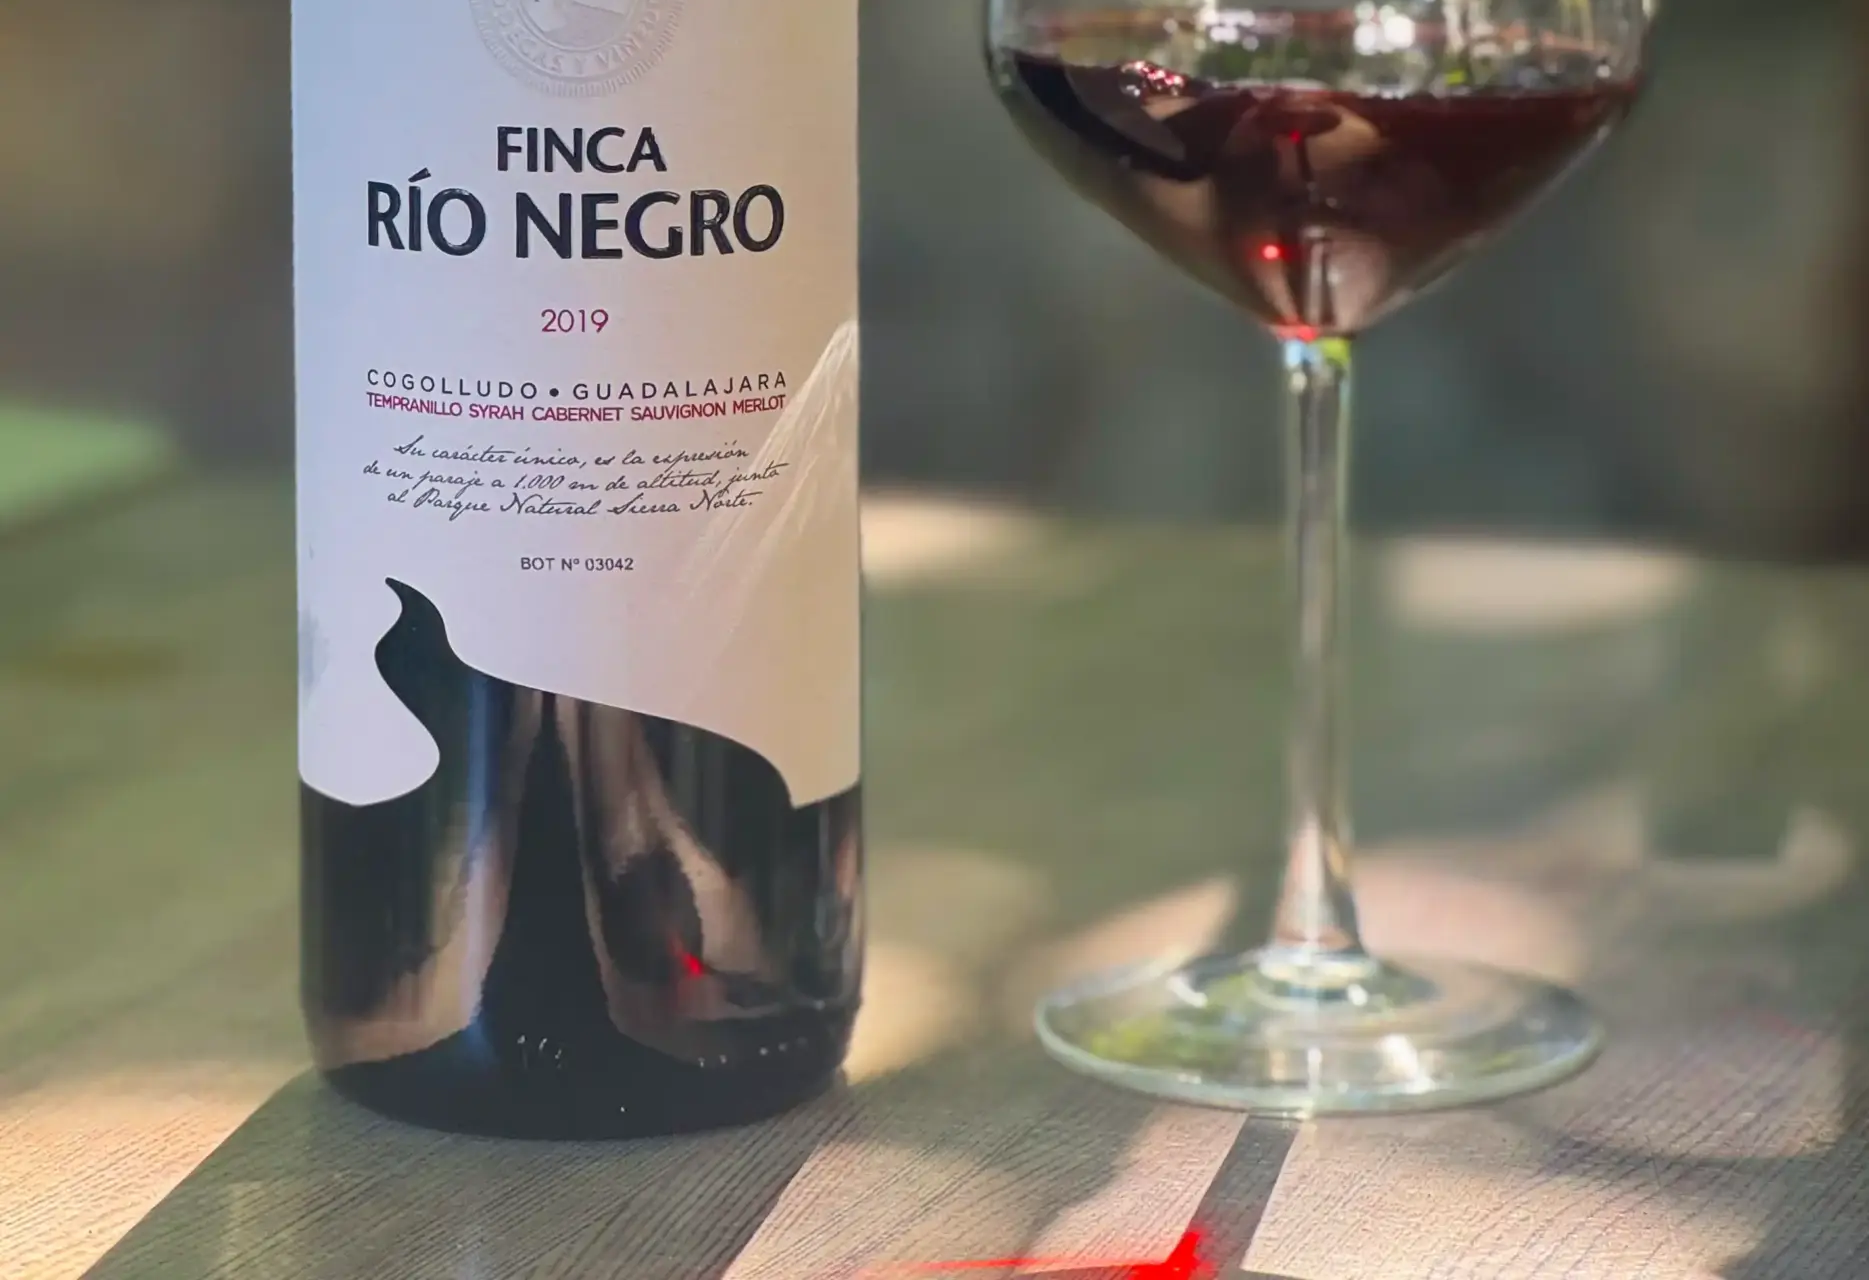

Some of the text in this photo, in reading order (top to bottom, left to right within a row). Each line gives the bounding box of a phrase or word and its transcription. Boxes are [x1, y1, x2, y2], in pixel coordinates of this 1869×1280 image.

[497, 126, 667, 173] FINCA
[367, 166, 785, 259] RÍO NEGRO
[540, 308, 609, 333] 2019
[367, 369, 787, 400] COGOLLUDO GUADALAJARA
[366, 391, 786, 422] TEMPRANILLO SYRAH CABERNET SAUVIGNON MERLOT
[393, 434, 749, 473] Su carácter único, es la expresión
[363, 460, 789, 500] de un paraje a 1.000 m de altitud, junto
[387, 487, 763, 521] al Parque Natural Sierra Norte.
[520, 557, 555, 570] BOT
[584, 557, 634, 571] 03042
